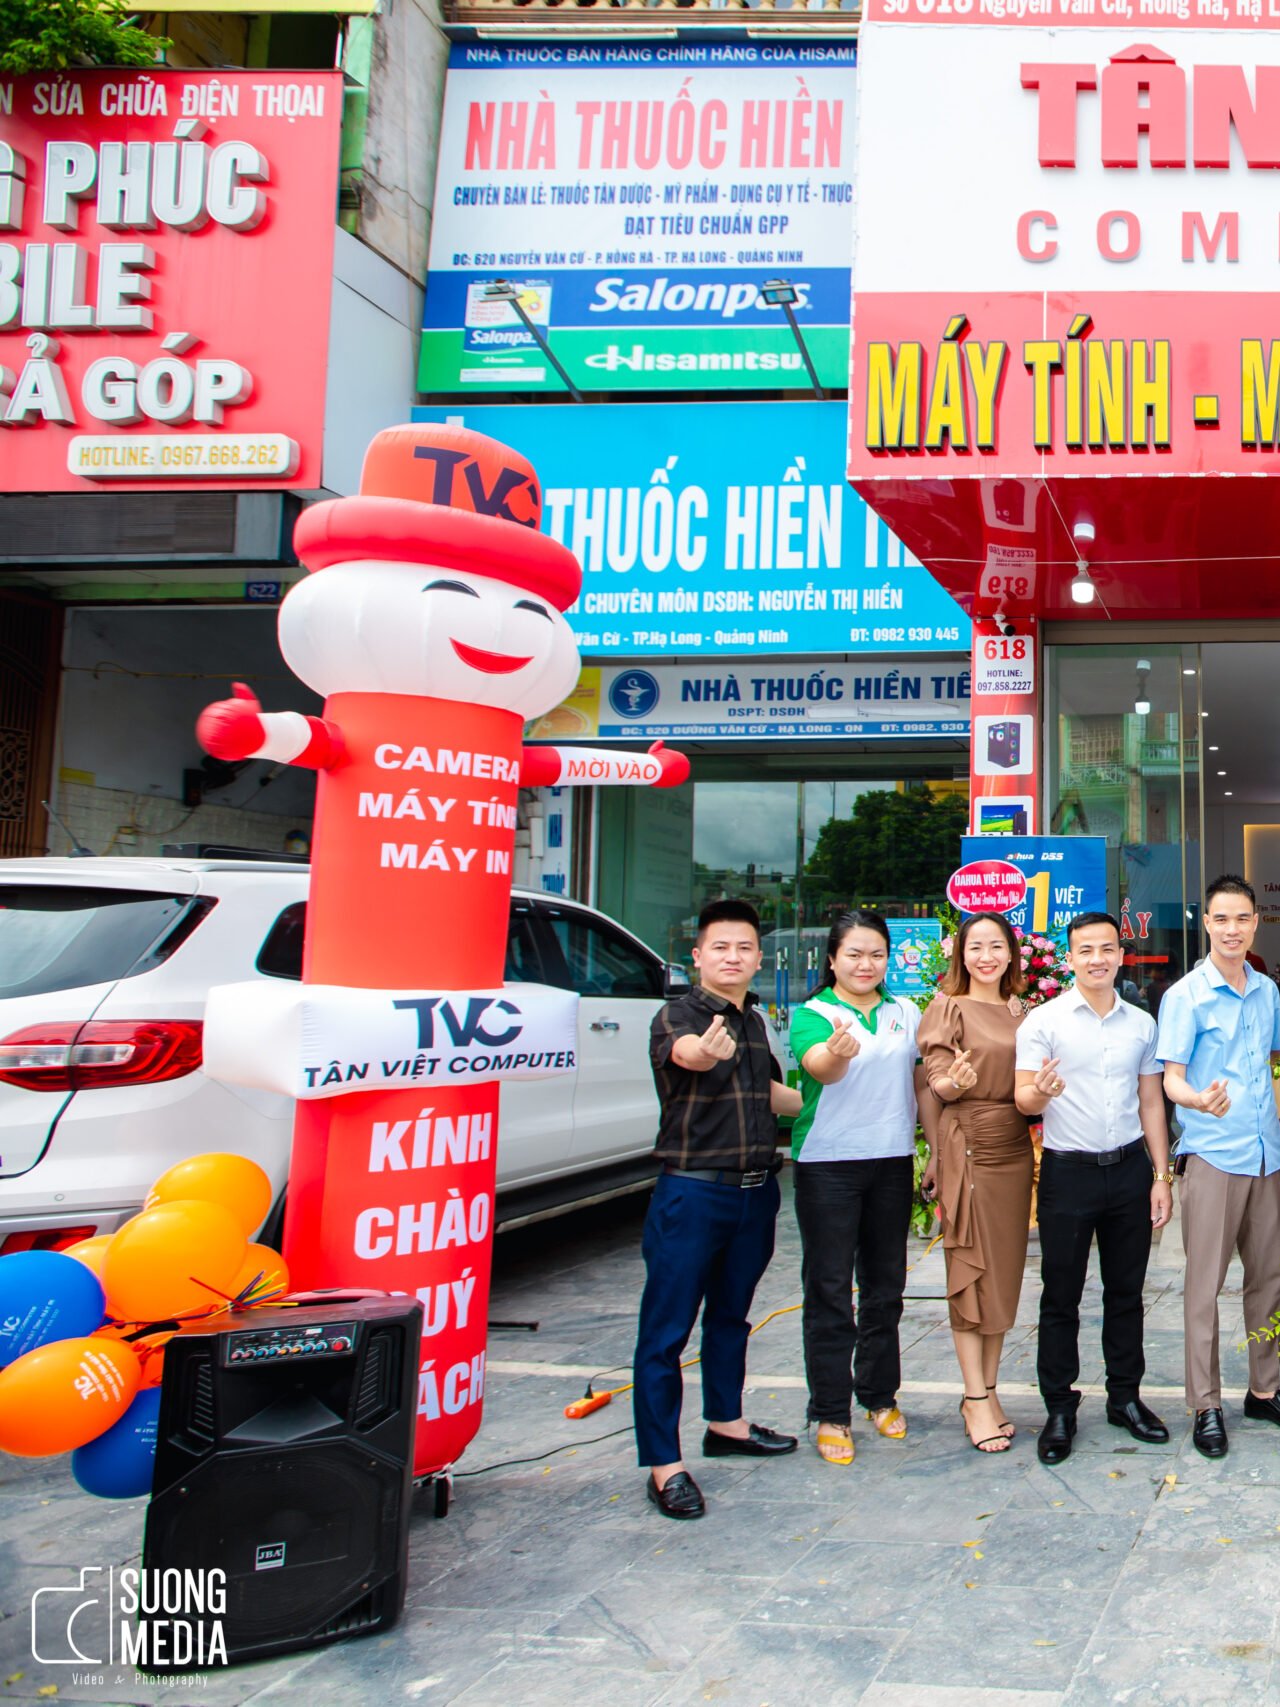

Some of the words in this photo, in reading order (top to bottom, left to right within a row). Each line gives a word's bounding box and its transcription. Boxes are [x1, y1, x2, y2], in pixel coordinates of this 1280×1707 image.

[466, 46, 501, 63] NHÀ
[33, 74, 83, 116] SỬA
[101, 75, 168, 116] CHỮA
[180, 79, 239, 123] ĐIỆN
[464, 89, 557, 170] NHÀ
[576, 76, 728, 170] THUỐC
[739, 76, 844, 169] HIỀN
[43, 118, 269, 231] PHÚC
[624, 216, 655, 238] ĐẠT
[660, 213, 694, 235] TIÊU
[699, 208, 753, 235] CHUẨN
[759, 216, 789, 234] GPP
[475, 253, 495, 265] 620
[699, 251, 726, 263] LONG
[777, 251, 803, 262] NINH
[82, 332, 253, 426] GÓP
[865, 313, 1009, 455] MÁY
[1024, 313, 1172, 453] TÍNH
[80, 446, 154, 468] HOTLINE:
[161, 445, 279, 467] 0967.668.262
[544, 456, 709, 572] THUỐC
[724, 456, 843, 570] HIỀN
[249, 584, 277, 599] 622
[584, 587, 653, 614] CHUYÊN
[658, 587, 698, 613] MÔN
[703, 591, 754, 612] DSĐH:
[758, 582, 827, 611] NGUYỄN
[832, 589, 858, 614] THỊ
[671, 631, 702, 646] Long
[714, 629, 755, 645] Quảng
[758, 629, 788, 643] Ninh
[851, 628, 869, 641] ĐT:
[873, 628, 904, 641] 0982
[908, 628, 932, 640] 930
[935, 627, 959, 640] 445
[983, 639, 1026, 661] 618
[681, 674, 741, 702] NHÀ
[751, 670, 844, 701] THUỐC
[854, 670, 921, 699] HIỀN
[978, 681, 1032, 691] 097.858.2227
[987, 669, 1023, 678] HOTLINE:
[728, 708, 765, 717] DSPT:
[769, 707, 806, 717] DSĐH
[800, 725, 832, 733] LONG
[903, 724, 937, 732] 0982.
[941, 723, 964, 731] 930
[374, 743, 521, 785] CAMERA
[568, 756, 610, 780] MỜI
[618, 757, 658, 781] VÀO
[357, 789, 456, 822] MÁY
[380, 839, 477, 875] MÁY
[486, 849, 510, 876] IN
[1041, 852, 1064, 860] DSS
[955, 874, 982, 886] DAHUA
[984, 872, 1001, 888] VIỆT
[1002, 873, 1022, 885] LONG
[1011, 907, 1027, 925] SỐ
[1026, 872, 1050, 932] 1
[1055, 885, 1084, 907] VIỆT
[392, 997, 524, 1049] TVC
[304, 1060, 370, 1088] TÂN
[381, 1053, 440, 1081] VIỆT
[449, 1051, 576, 1074] COMPUTER
[368, 1107, 492, 1173] KÍNH
[354, 1188, 489, 1261] CHÀO
